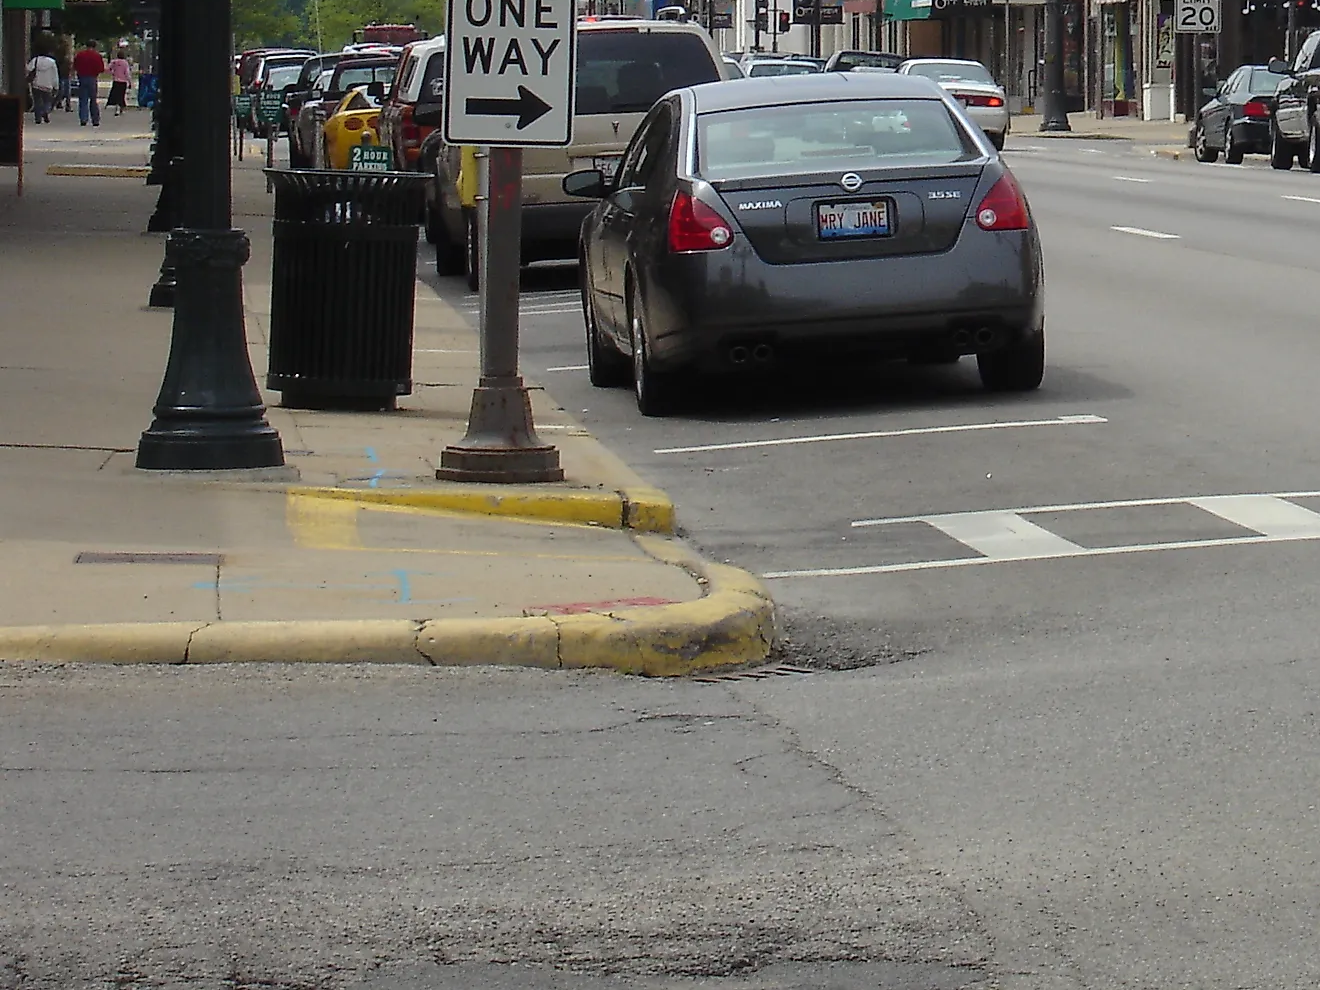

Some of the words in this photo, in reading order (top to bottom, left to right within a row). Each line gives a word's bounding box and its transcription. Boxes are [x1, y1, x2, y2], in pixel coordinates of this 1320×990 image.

[1181, 6, 1215, 26] 20
[462, 36, 561, 76] WAY
[352, 148, 361, 162] 2
[363, 152, 388, 160] HOUR
[738, 199, 783, 210] MAXIMA
[853, 210, 886, 229] JANE
